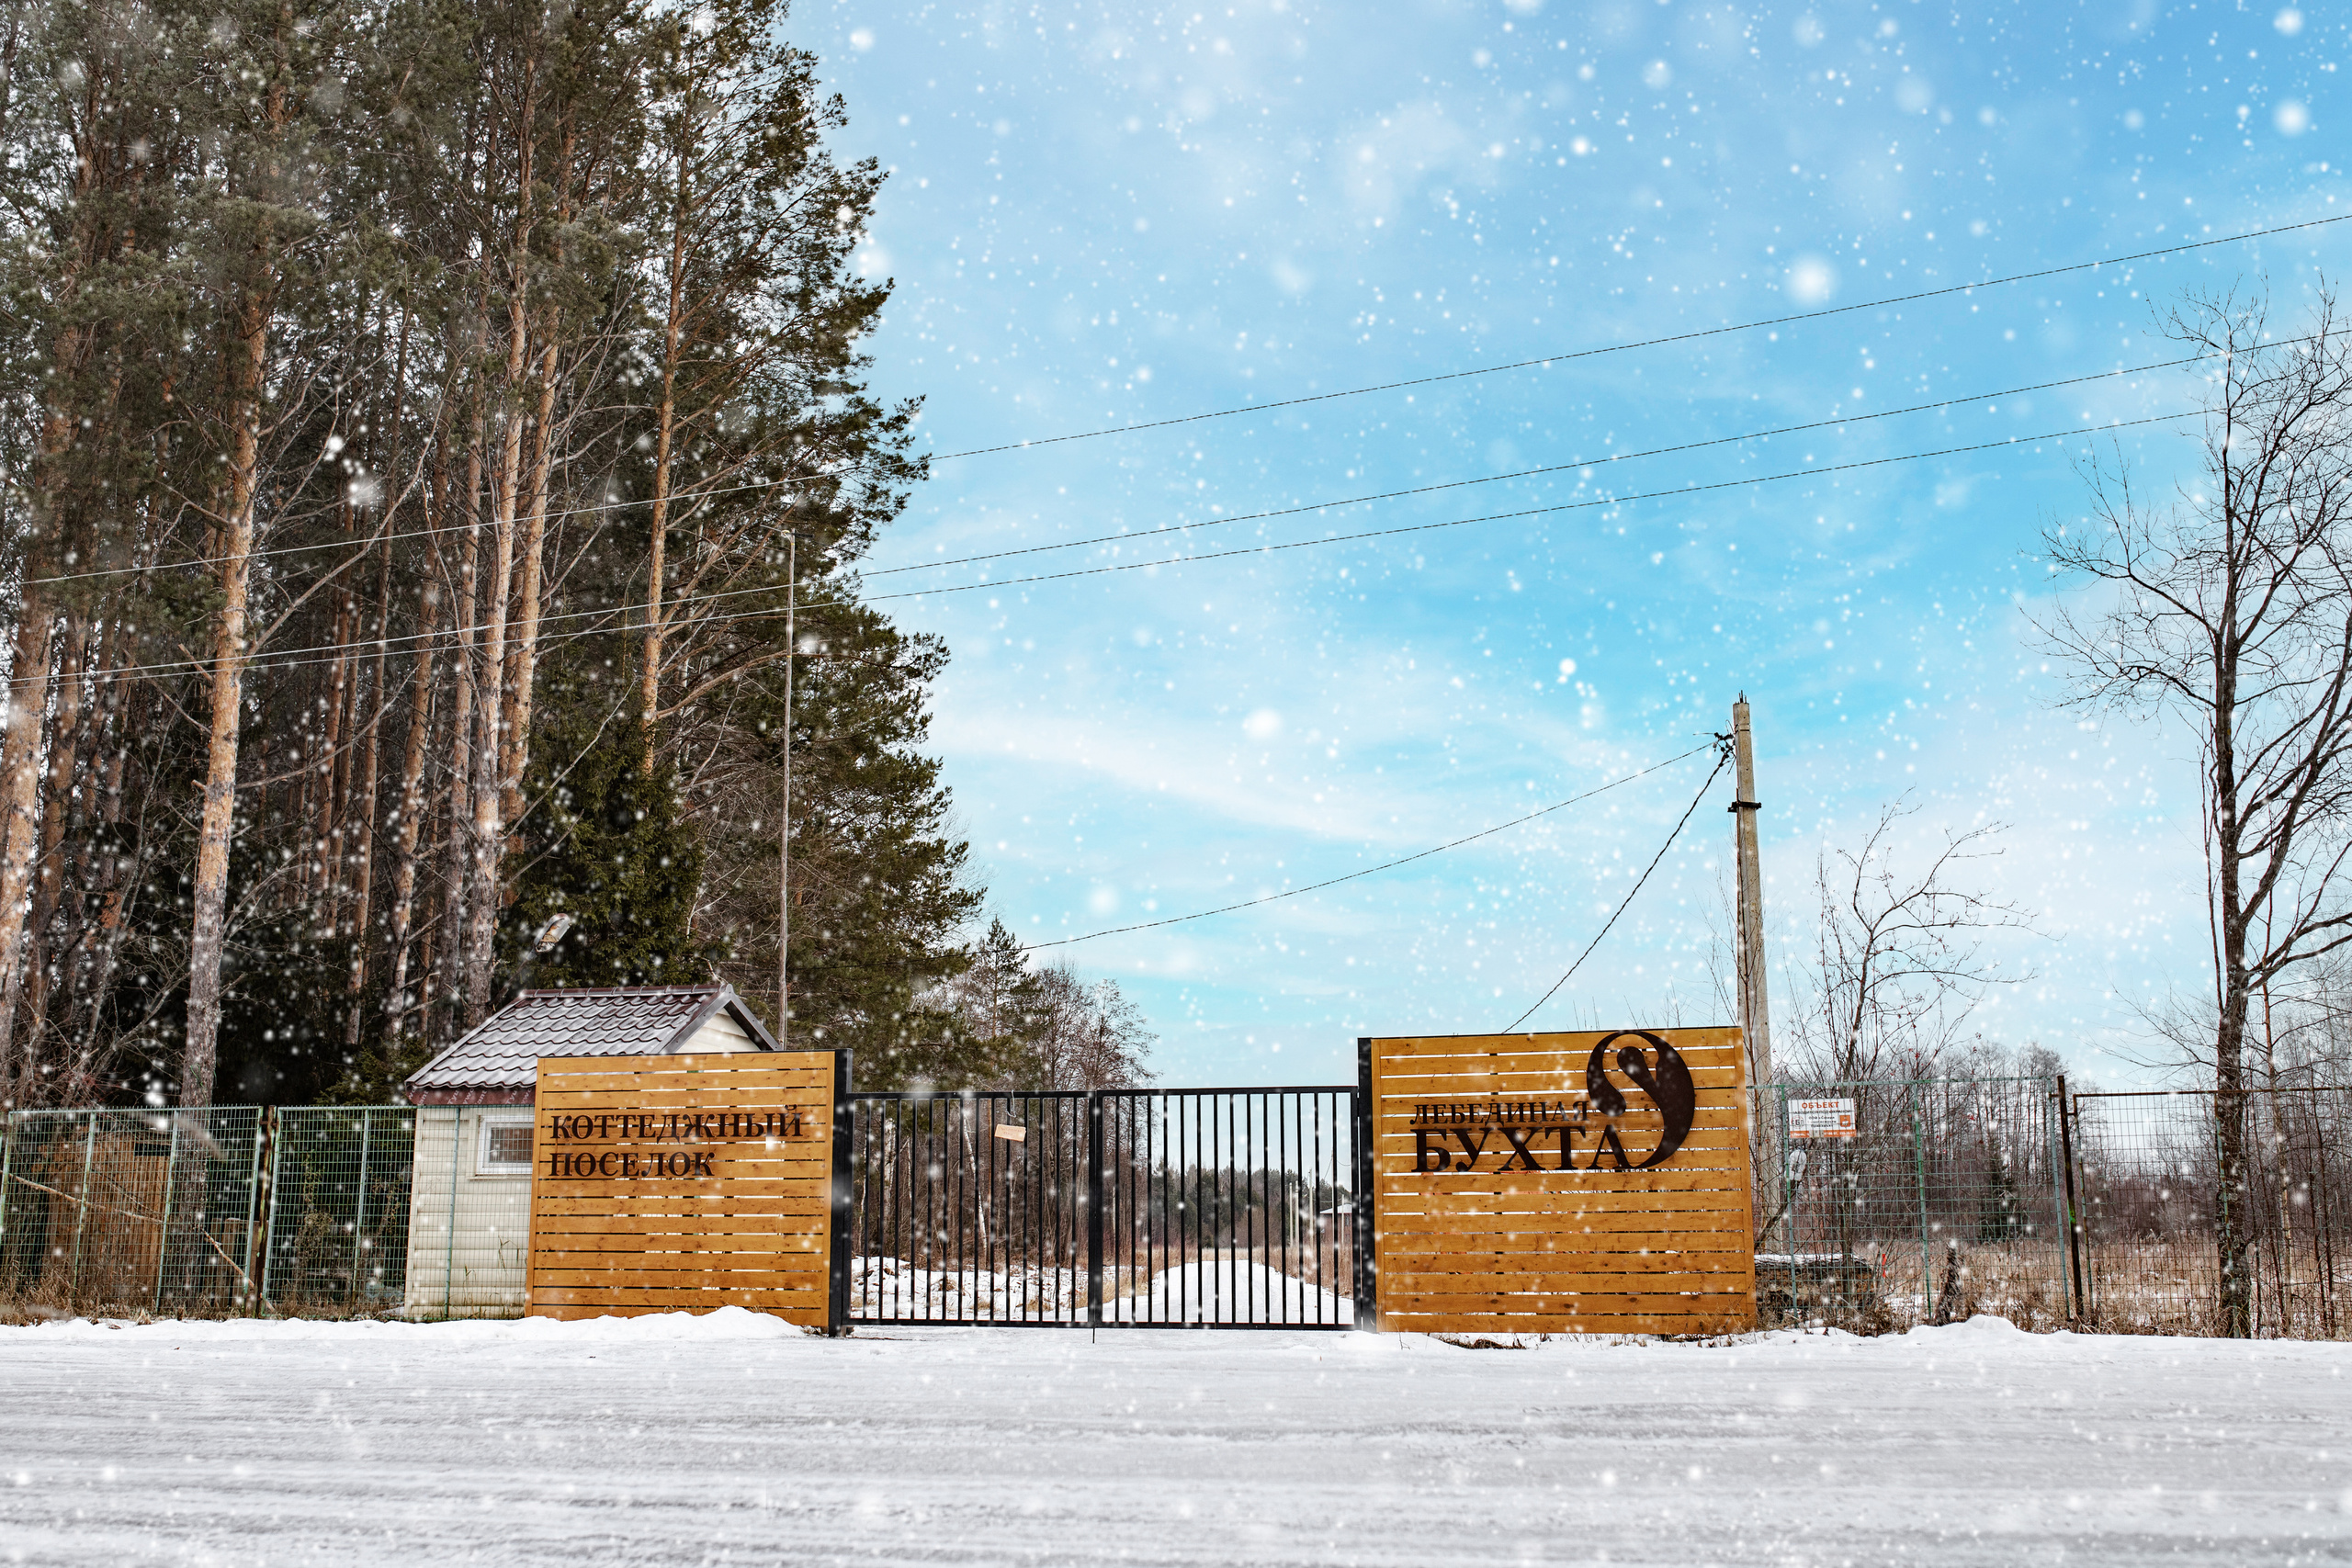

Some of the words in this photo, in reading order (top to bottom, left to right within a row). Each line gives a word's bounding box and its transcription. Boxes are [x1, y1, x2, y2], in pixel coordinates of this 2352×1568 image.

[549, 1104, 804, 1144] КОТТЕДЖНЫЙ
[1409, 1100, 1590, 1126] ЛЕБЕДИНАЯ
[1410, 1123, 1633, 1173] БУХТА
[548, 1152, 715, 1178] ПОСЕЛОК
